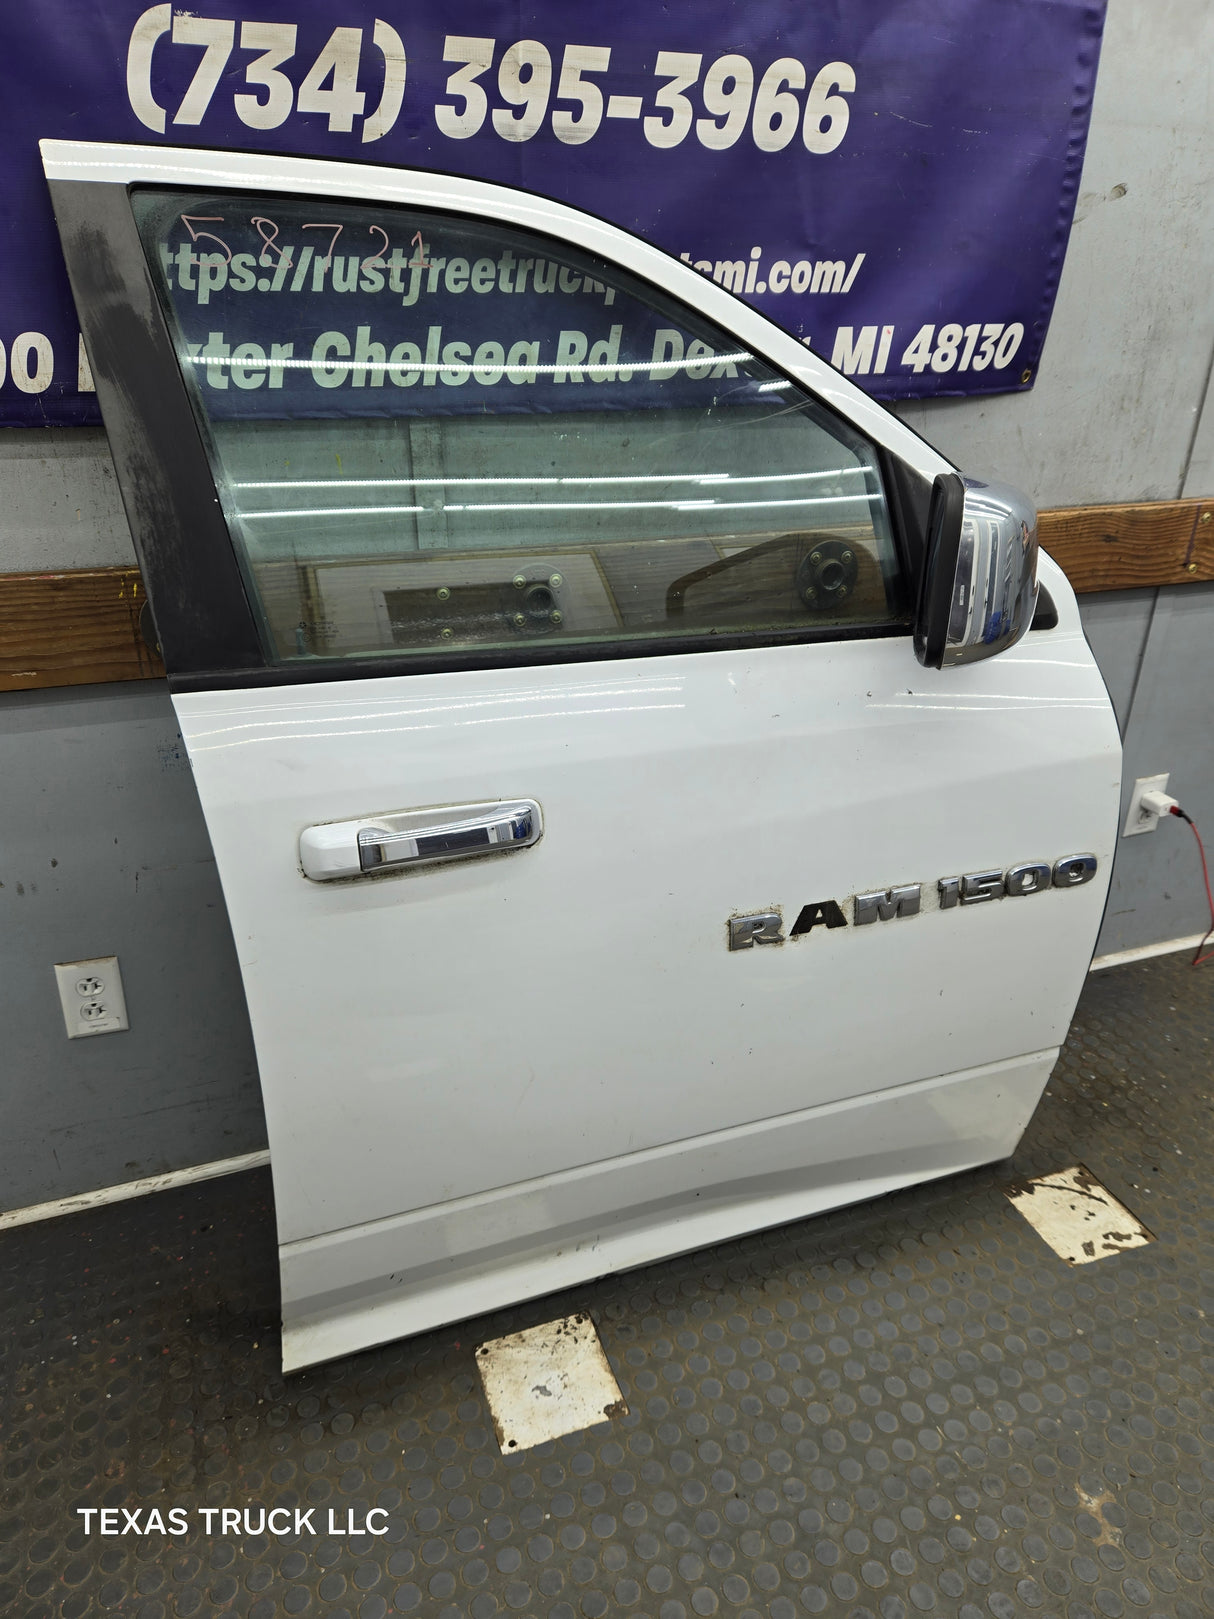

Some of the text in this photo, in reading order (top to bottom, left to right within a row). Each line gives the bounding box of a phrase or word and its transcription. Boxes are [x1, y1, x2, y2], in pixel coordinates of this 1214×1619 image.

[126, 3, 857, 154] (734) 395-3966
[0, 331, 54, 394] 0
[311, 325, 540, 389] Chelsea
[553, 324, 634, 384] Rd.
[830, 325, 895, 375] MI
[900, 322, 1025, 374] 48130
[728, 852, 1098, 952] RAM 1500
